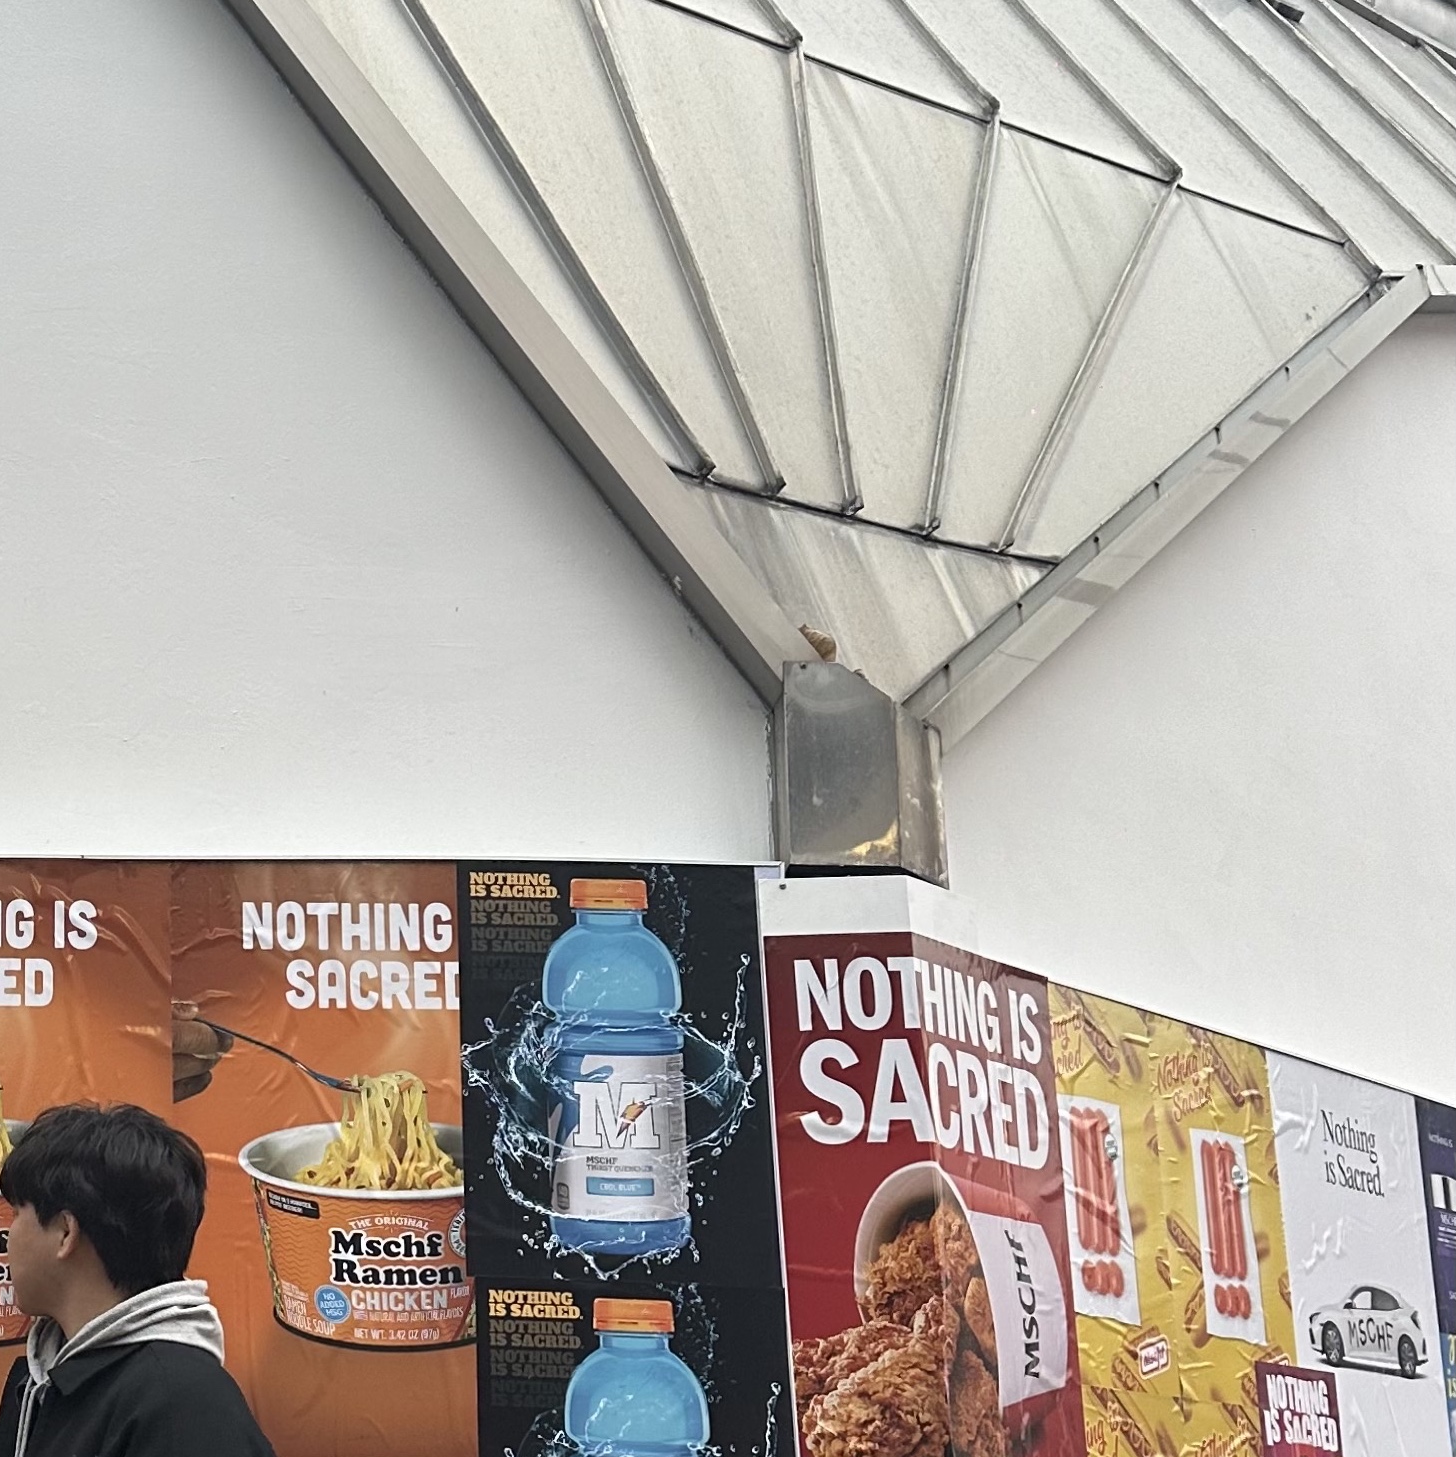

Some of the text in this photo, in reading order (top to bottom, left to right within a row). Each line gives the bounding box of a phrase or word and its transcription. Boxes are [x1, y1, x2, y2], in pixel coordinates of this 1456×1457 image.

[470, 872, 550, 885] NOTHING
[470, 885, 560, 898] IS SACRED.
[55, 900, 97, 949] IS
[243, 901, 452, 952] NOTHING
[794, 957, 1041, 1064] NOTHING IS
[799, 1038, 1049, 1170] SACRED
[1321, 1110, 1377, 1164] Nothing
[1324, 1150, 1384, 1197] is Sacred.
[332, 1231, 442, 1257] Mschf
[332, 1258, 463, 1286] Ramen
[351, 1290, 446, 1311] CHICKEN
[489, 1290, 573, 1305] NOTHING
[489, 1303, 583, 1319] IS SACRED.
[1005, 1230, 1039, 1378] MSCHF
[1348, 1318, 1393, 1352] MSCHF
[1266, 1374, 1329, 1416] NOTHING
[1263, 1408, 1338, 1451] IS SACRED
